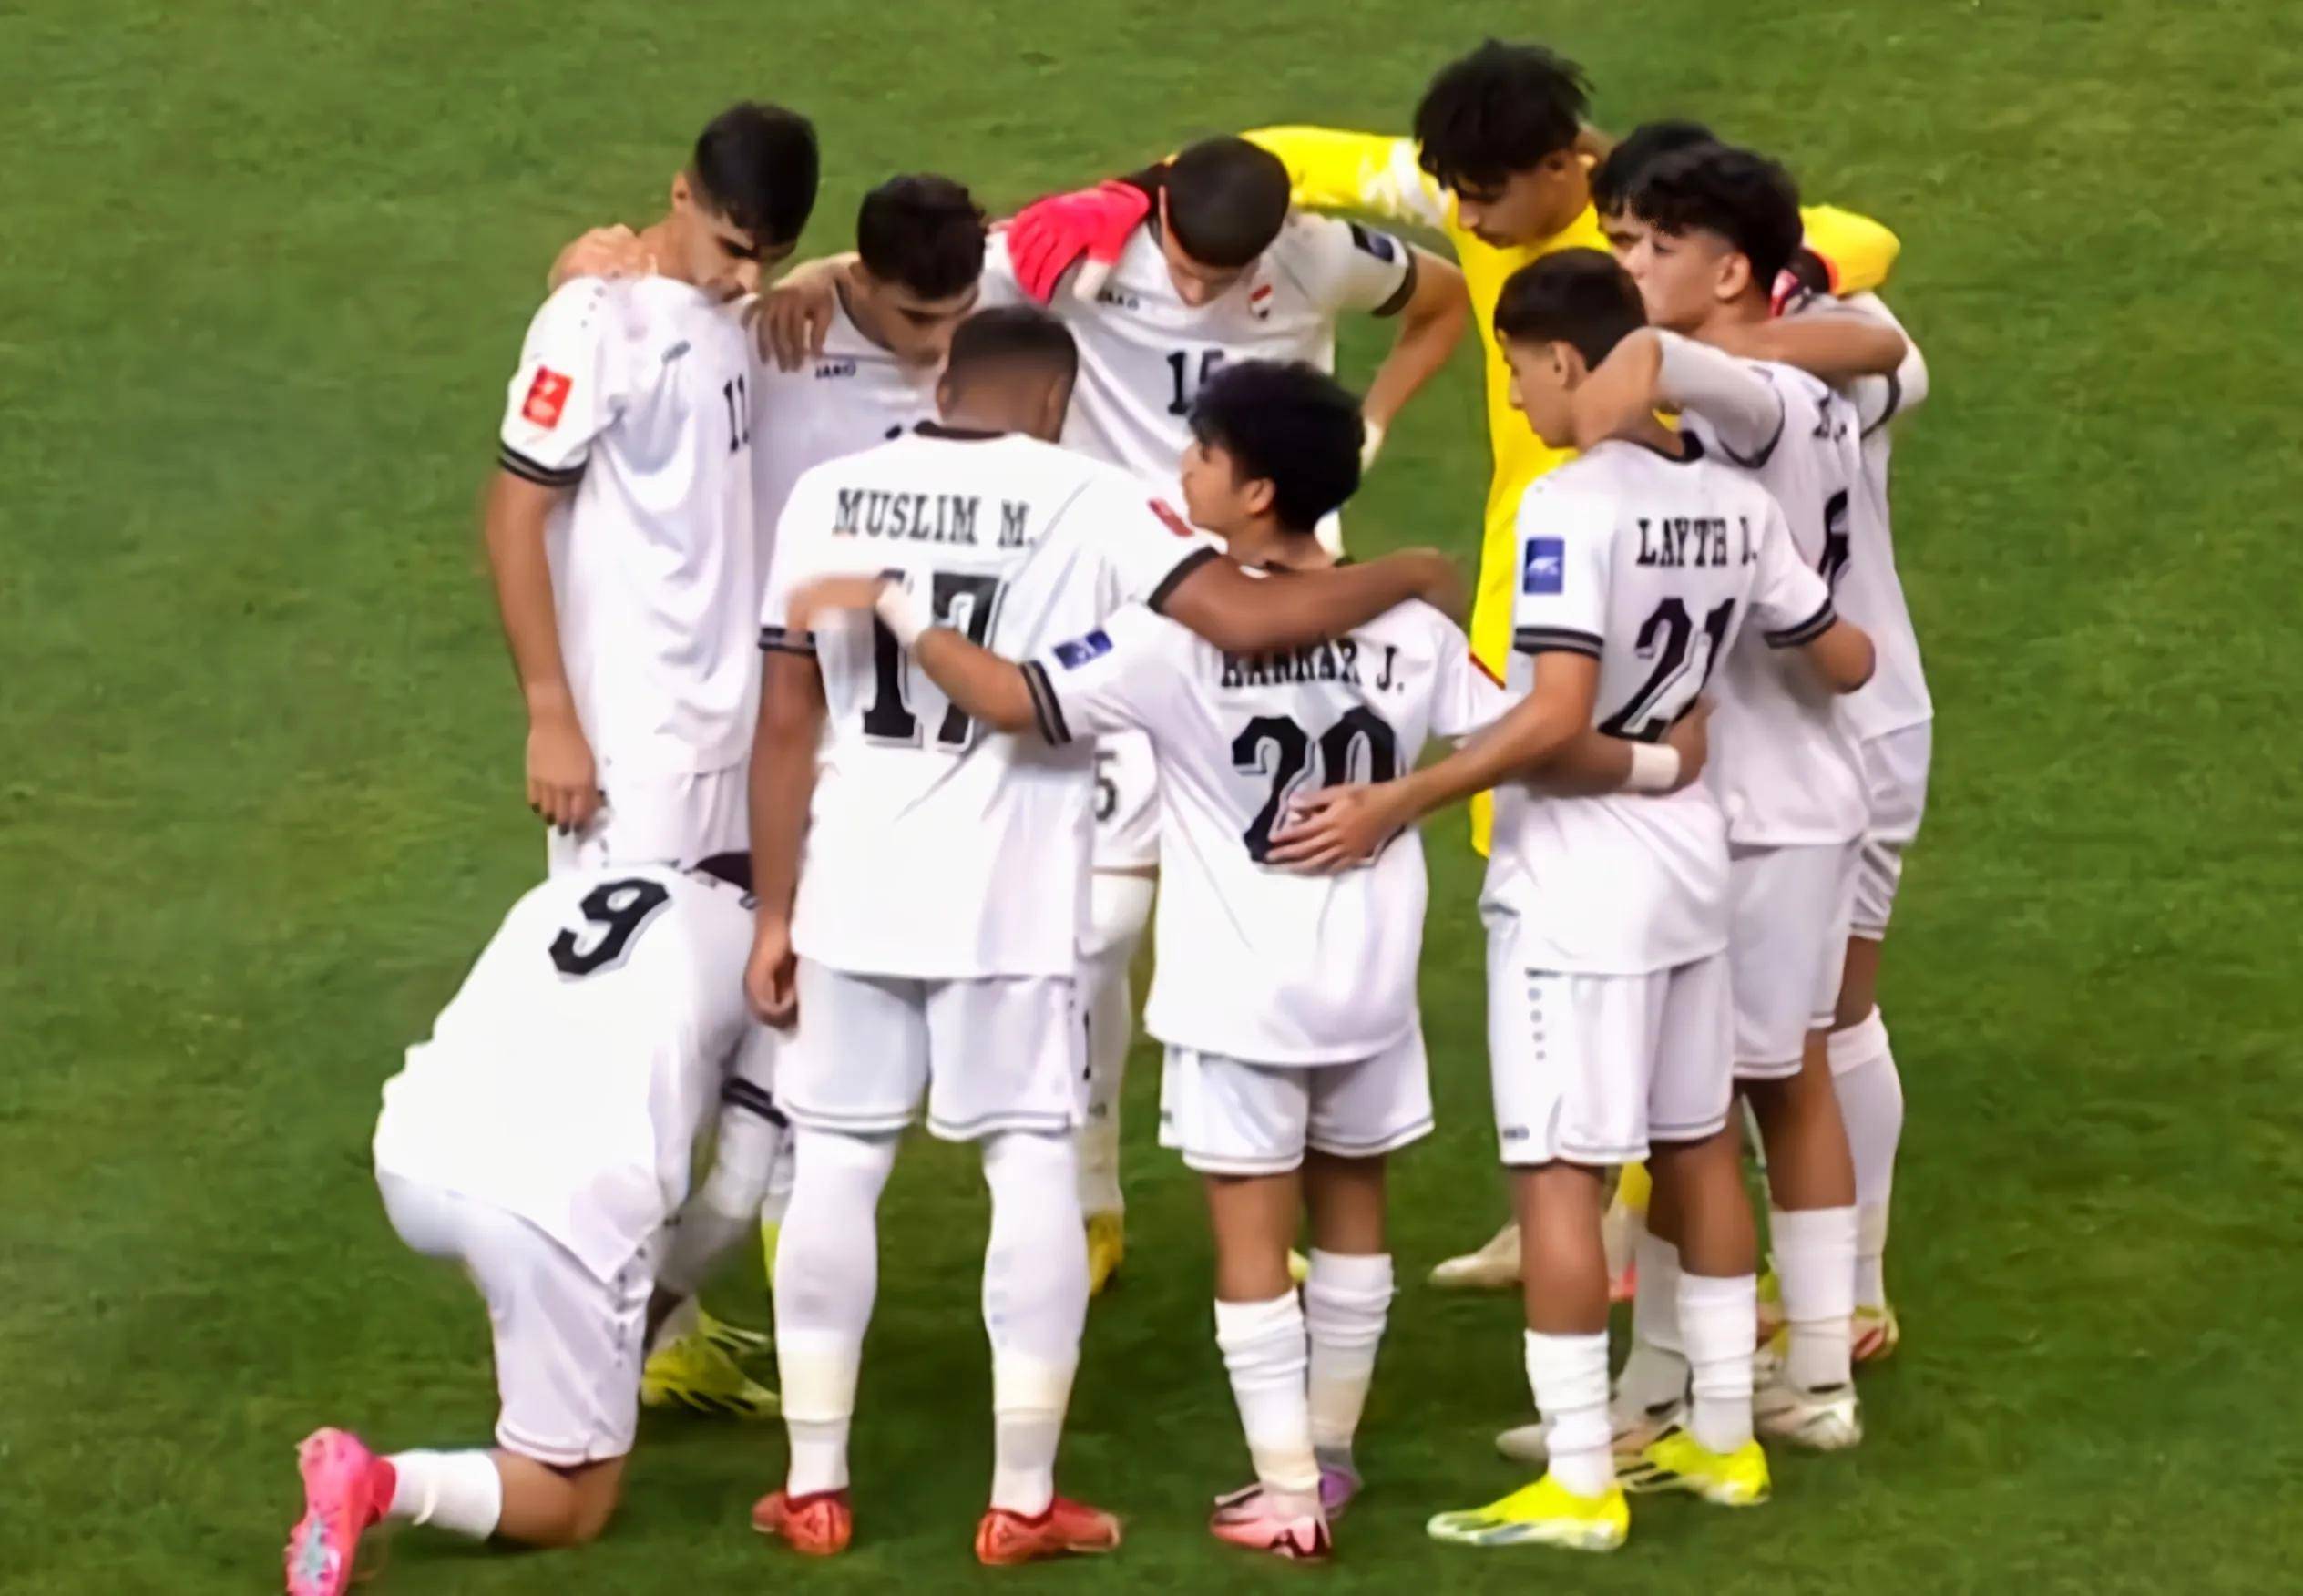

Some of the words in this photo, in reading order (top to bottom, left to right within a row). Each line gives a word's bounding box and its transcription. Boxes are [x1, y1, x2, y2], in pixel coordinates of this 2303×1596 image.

[833, 487, 980, 545] MUSLIM
[997, 500, 1036, 547] M.
[1636, 517, 1727, 567] LAYTH
[863, 568, 1008, 749] 17
[1377, 644, 1405, 691] J.
[1598, 597, 1736, 743] 21
[548, 877, 671, 980] 9
